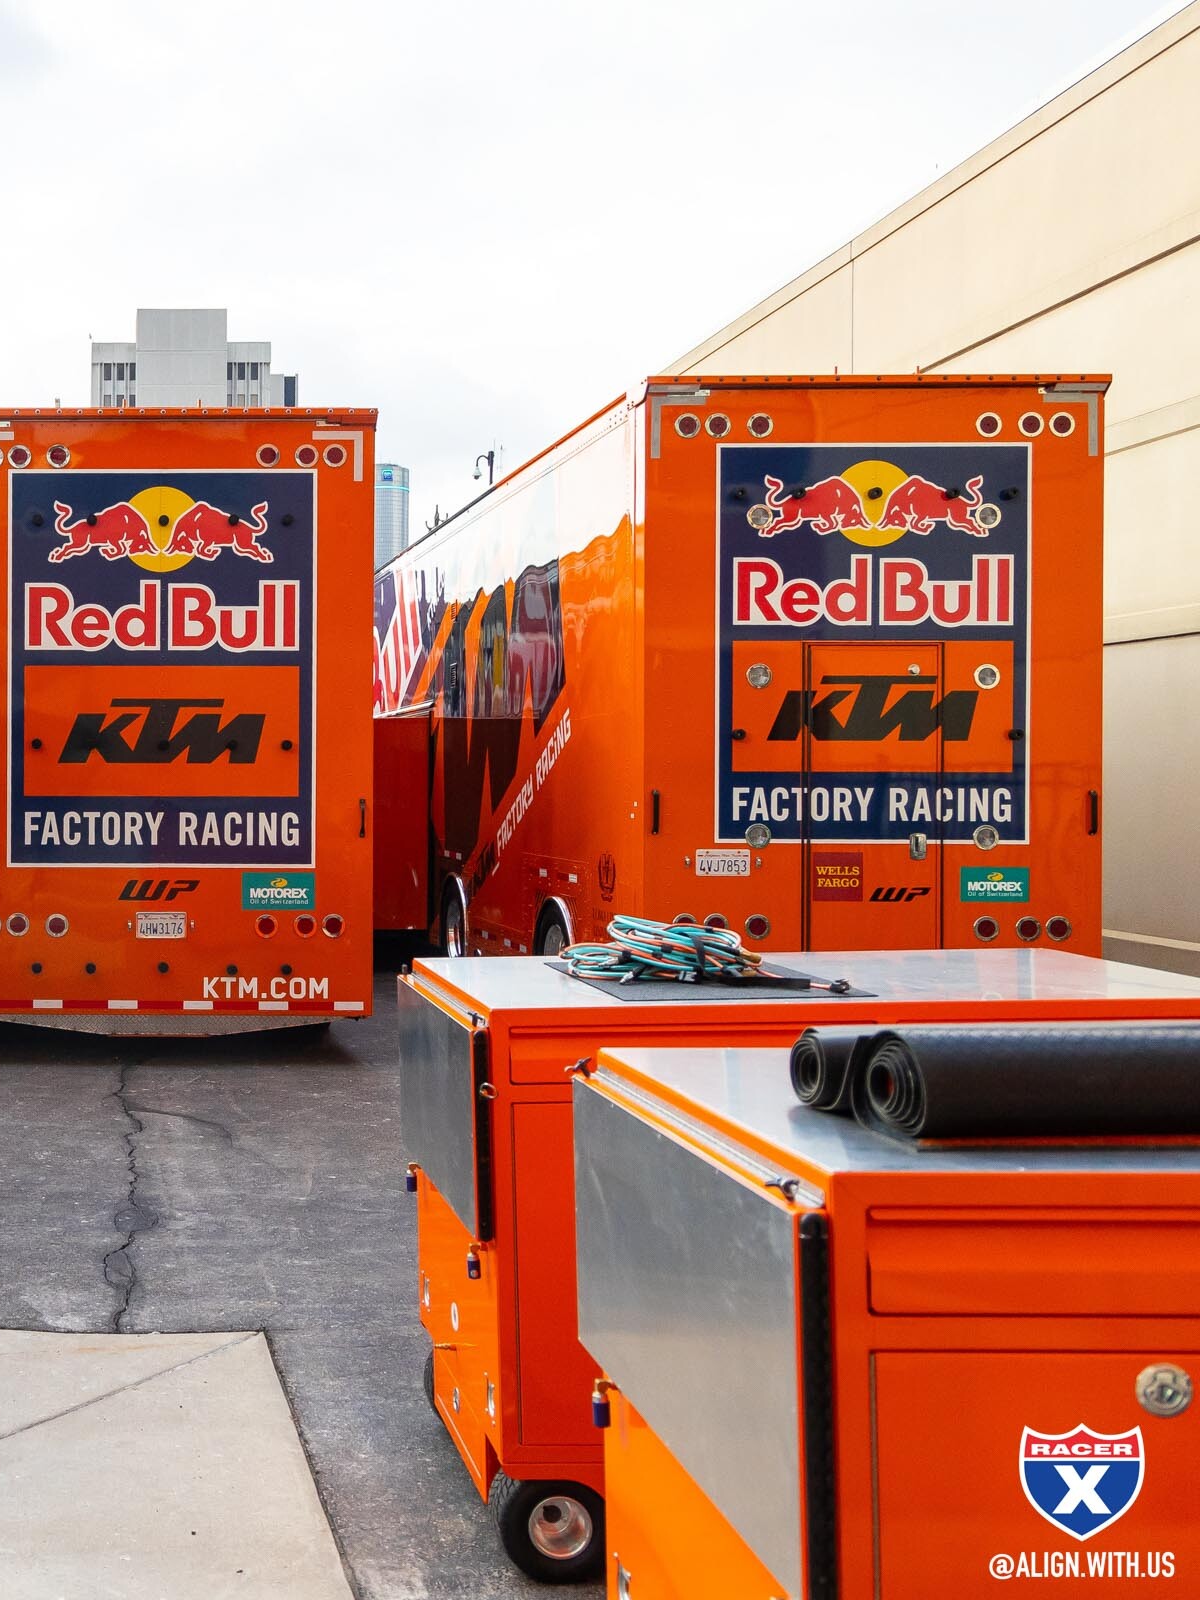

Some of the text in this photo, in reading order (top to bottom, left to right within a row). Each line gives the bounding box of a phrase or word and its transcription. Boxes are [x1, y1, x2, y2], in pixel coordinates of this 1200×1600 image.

[733, 554, 1014, 628] Red Bull
[25, 580, 300, 653] Red Bull
[767, 675, 979, 741] KTM
[58, 698, 266, 764] KTM
[496, 774, 534, 857] FACTORY
[732, 786, 1012, 823] FACTORY RACING
[24, 811, 300, 847] FACTORY RACING
[699, 860, 748, 873] 4VJ7853
[816, 866, 860, 876] WELLS
[118, 879, 200, 901] WP
[250, 888, 308, 899] MOTOREX
[816, 878, 859, 888] FARGO
[968, 881, 1022, 892] MOTOREX
[869, 887, 932, 903] WP
[139, 922, 184, 936] 4HW3176
[203, 976, 329, 999] KTM.COM
